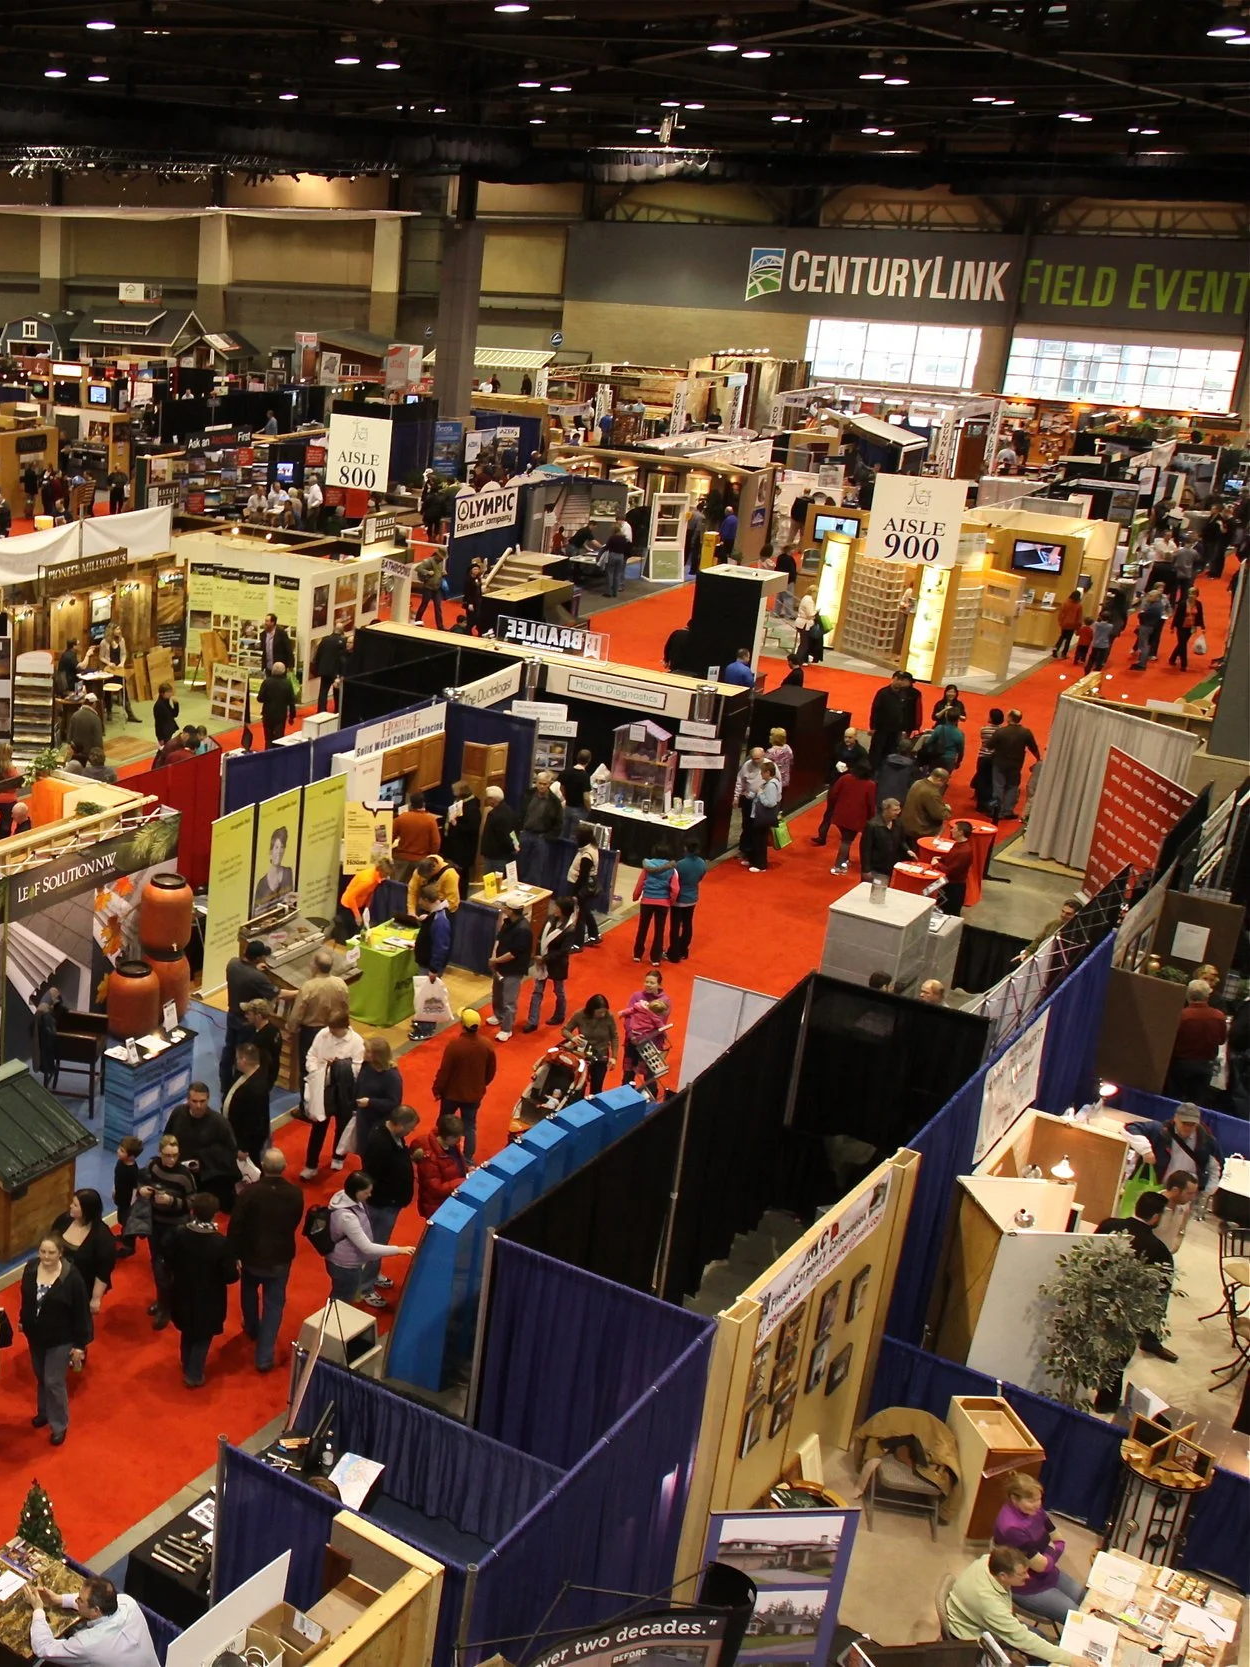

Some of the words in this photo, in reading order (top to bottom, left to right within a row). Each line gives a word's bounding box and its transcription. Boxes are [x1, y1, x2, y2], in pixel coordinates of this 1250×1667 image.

[788, 250, 1012, 302] CENTURYLINK
[1021, 259, 1118, 309] FIELD
[1128, 263, 1250, 315] EVENT
[672, 393, 682, 416] DUNN
[990, 411, 999, 434] DUNN
[188, 438, 200, 449] Ask
[201, 438, 210, 447] an
[238, 432, 251, 442] First
[940, 422, 950, 447] DUNN
[338, 451, 380, 466] AISLE
[1183, 454, 1204, 462] Trex
[339, 466, 376, 489] 800
[458, 493, 515, 522] OLYMPIC
[456, 519, 484, 532] Elevator
[882, 518, 946, 537] AISLE
[884, 534, 940, 562] 900
[48, 565, 81, 580] PIONEER
[81, 554, 127, 573] MILLWORKS
[464, 694, 476, 705] The
[576, 680, 603, 692] Home
[606, 685, 658, 704] Diagnostics
[382, 712, 421, 739] HERITAGE
[356, 744, 373, 757] Solid
[374, 740, 391, 751] Wood
[393, 730, 416, 745] Cabinet
[417, 722, 443, 737] Refacing
[42, 860, 95, 893] SOLUTION
[95, 852, 117, 872] NW
[574, 1636, 611, 1656] two
[612, 1648, 648, 1664] BEFORE
